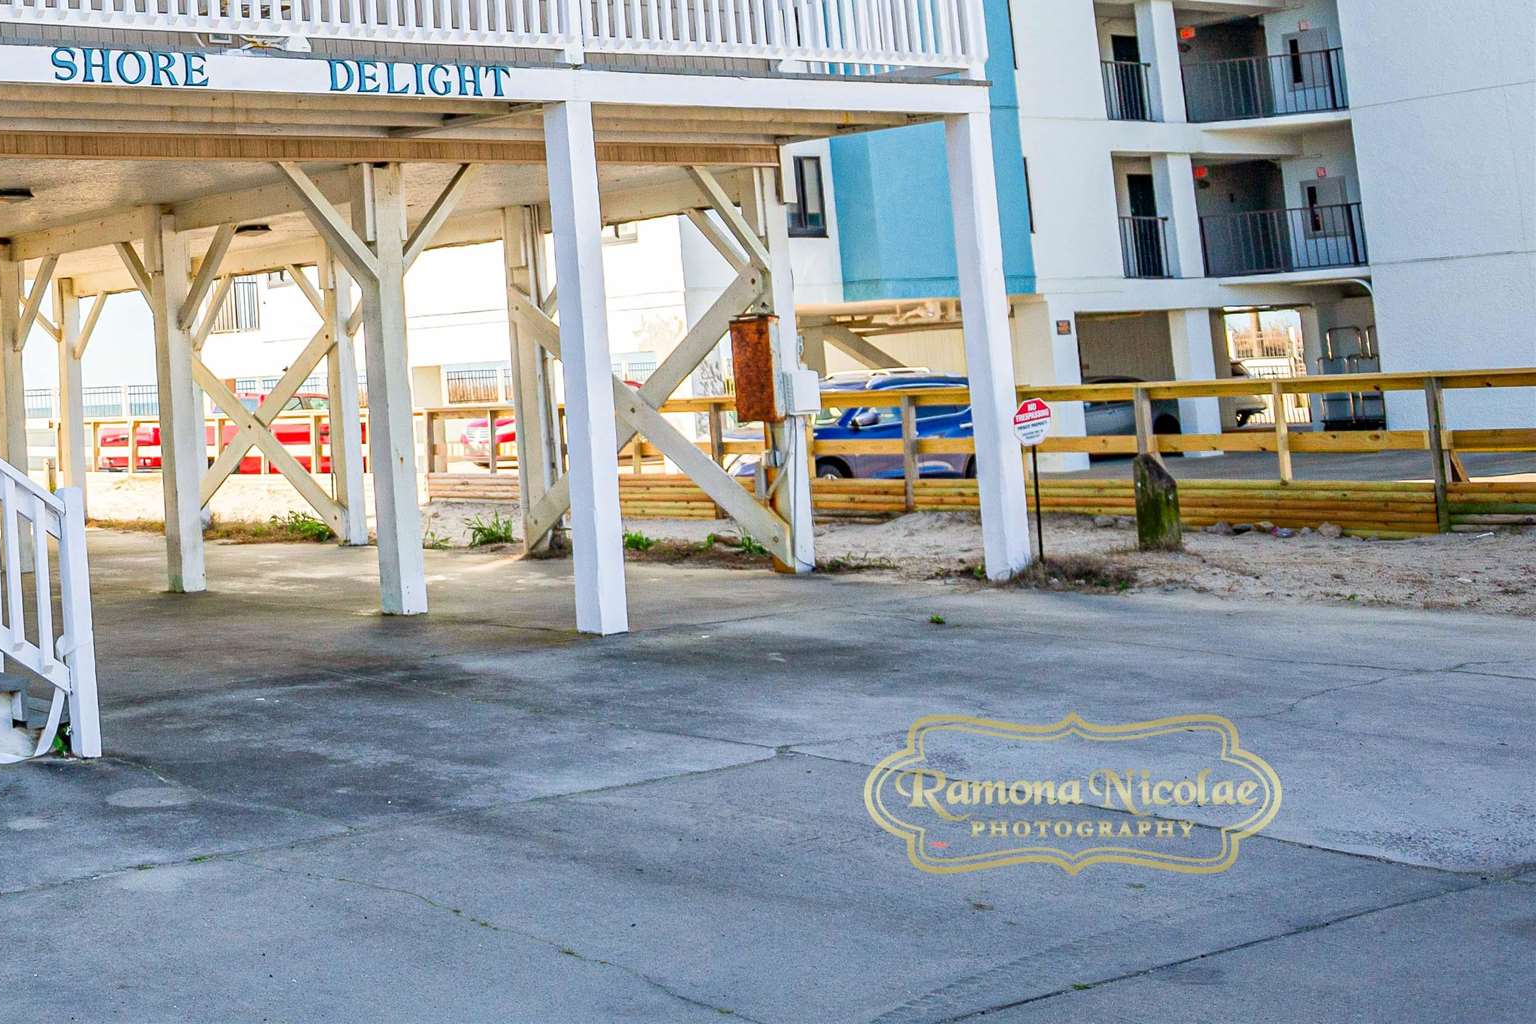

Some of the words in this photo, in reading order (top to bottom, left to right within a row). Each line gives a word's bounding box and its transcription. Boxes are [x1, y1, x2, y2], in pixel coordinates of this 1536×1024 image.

[50, 46, 209, 87] SHORE
[328, 59, 511, 97] DELIGHT
[1027, 403, 1037, 411] NO
